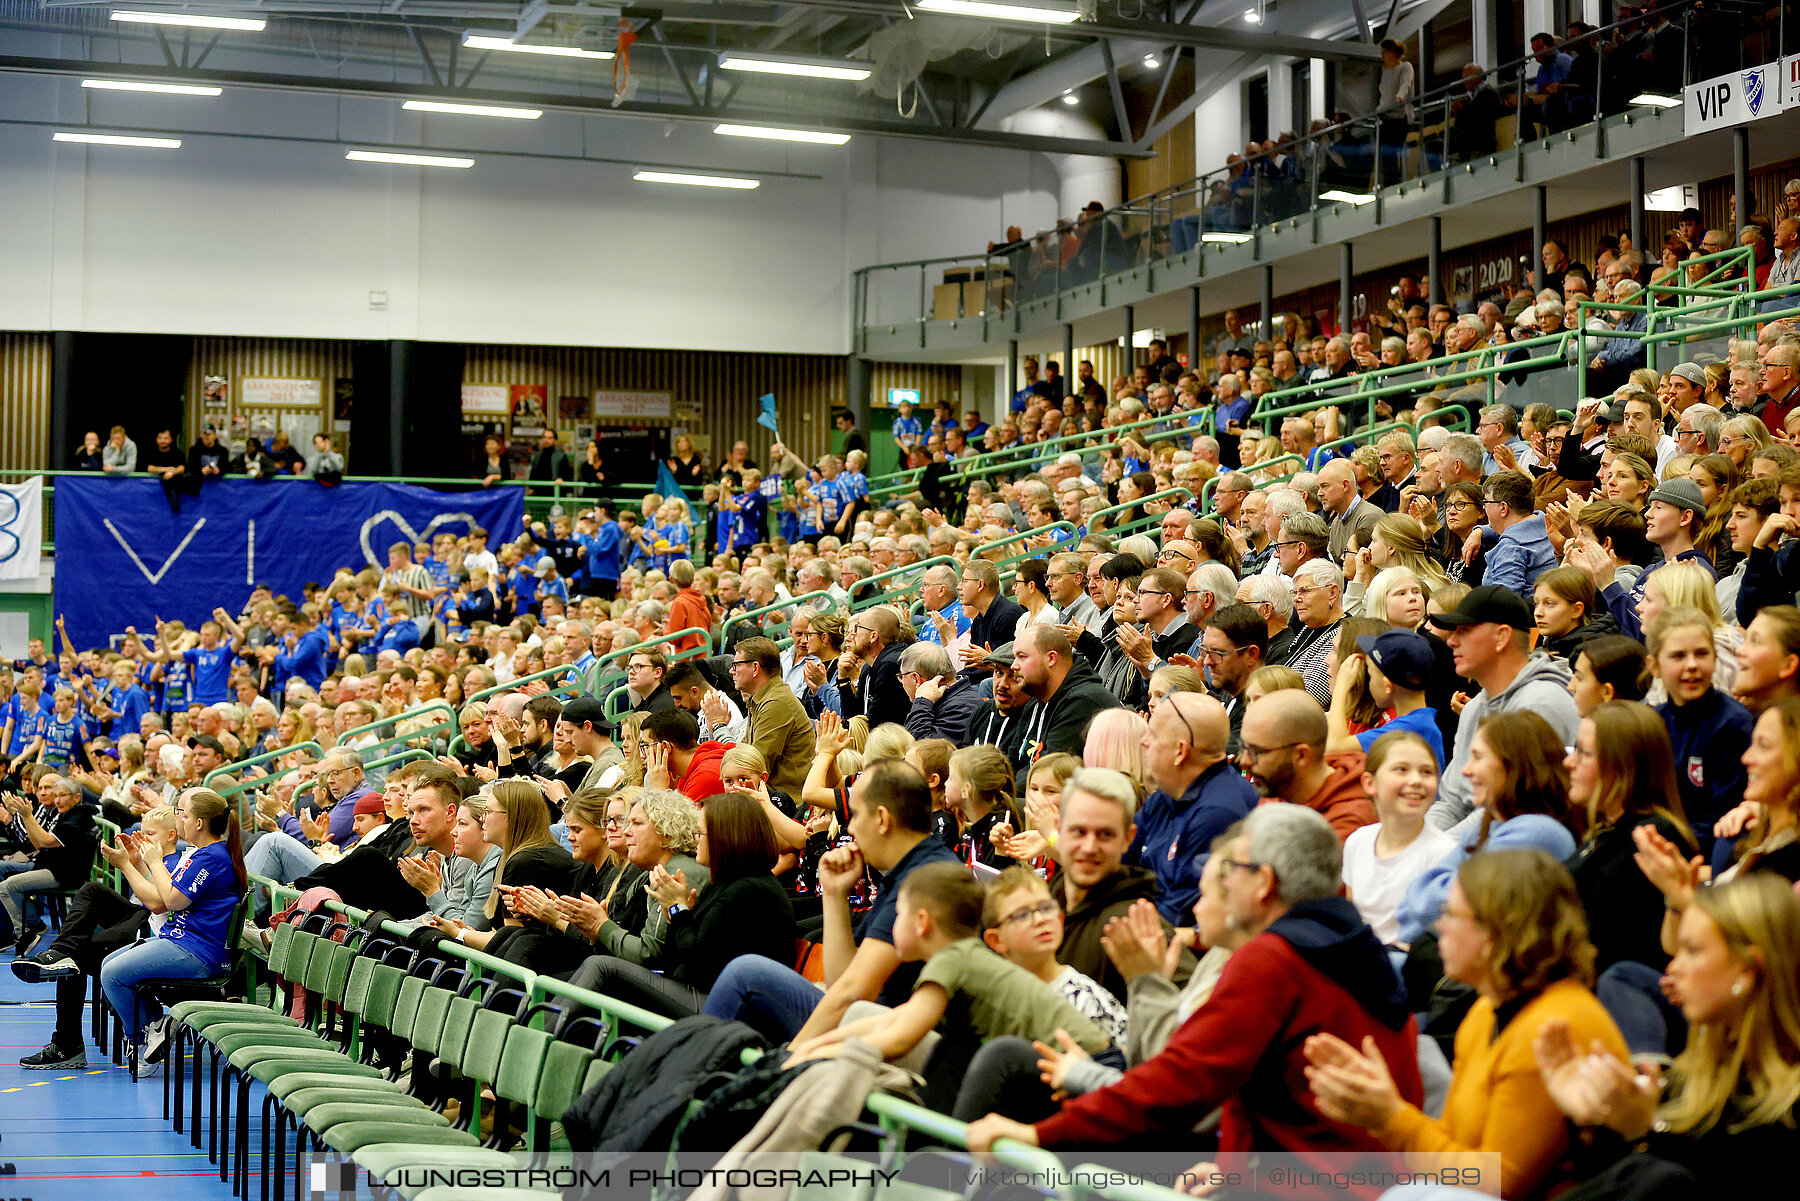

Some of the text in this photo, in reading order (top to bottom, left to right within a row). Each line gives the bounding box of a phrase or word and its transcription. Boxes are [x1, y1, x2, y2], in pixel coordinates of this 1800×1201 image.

[1696, 83, 1731, 121] VIP
[1480, 256, 1512, 288] 2020
[461, 398, 481, 408] 016
